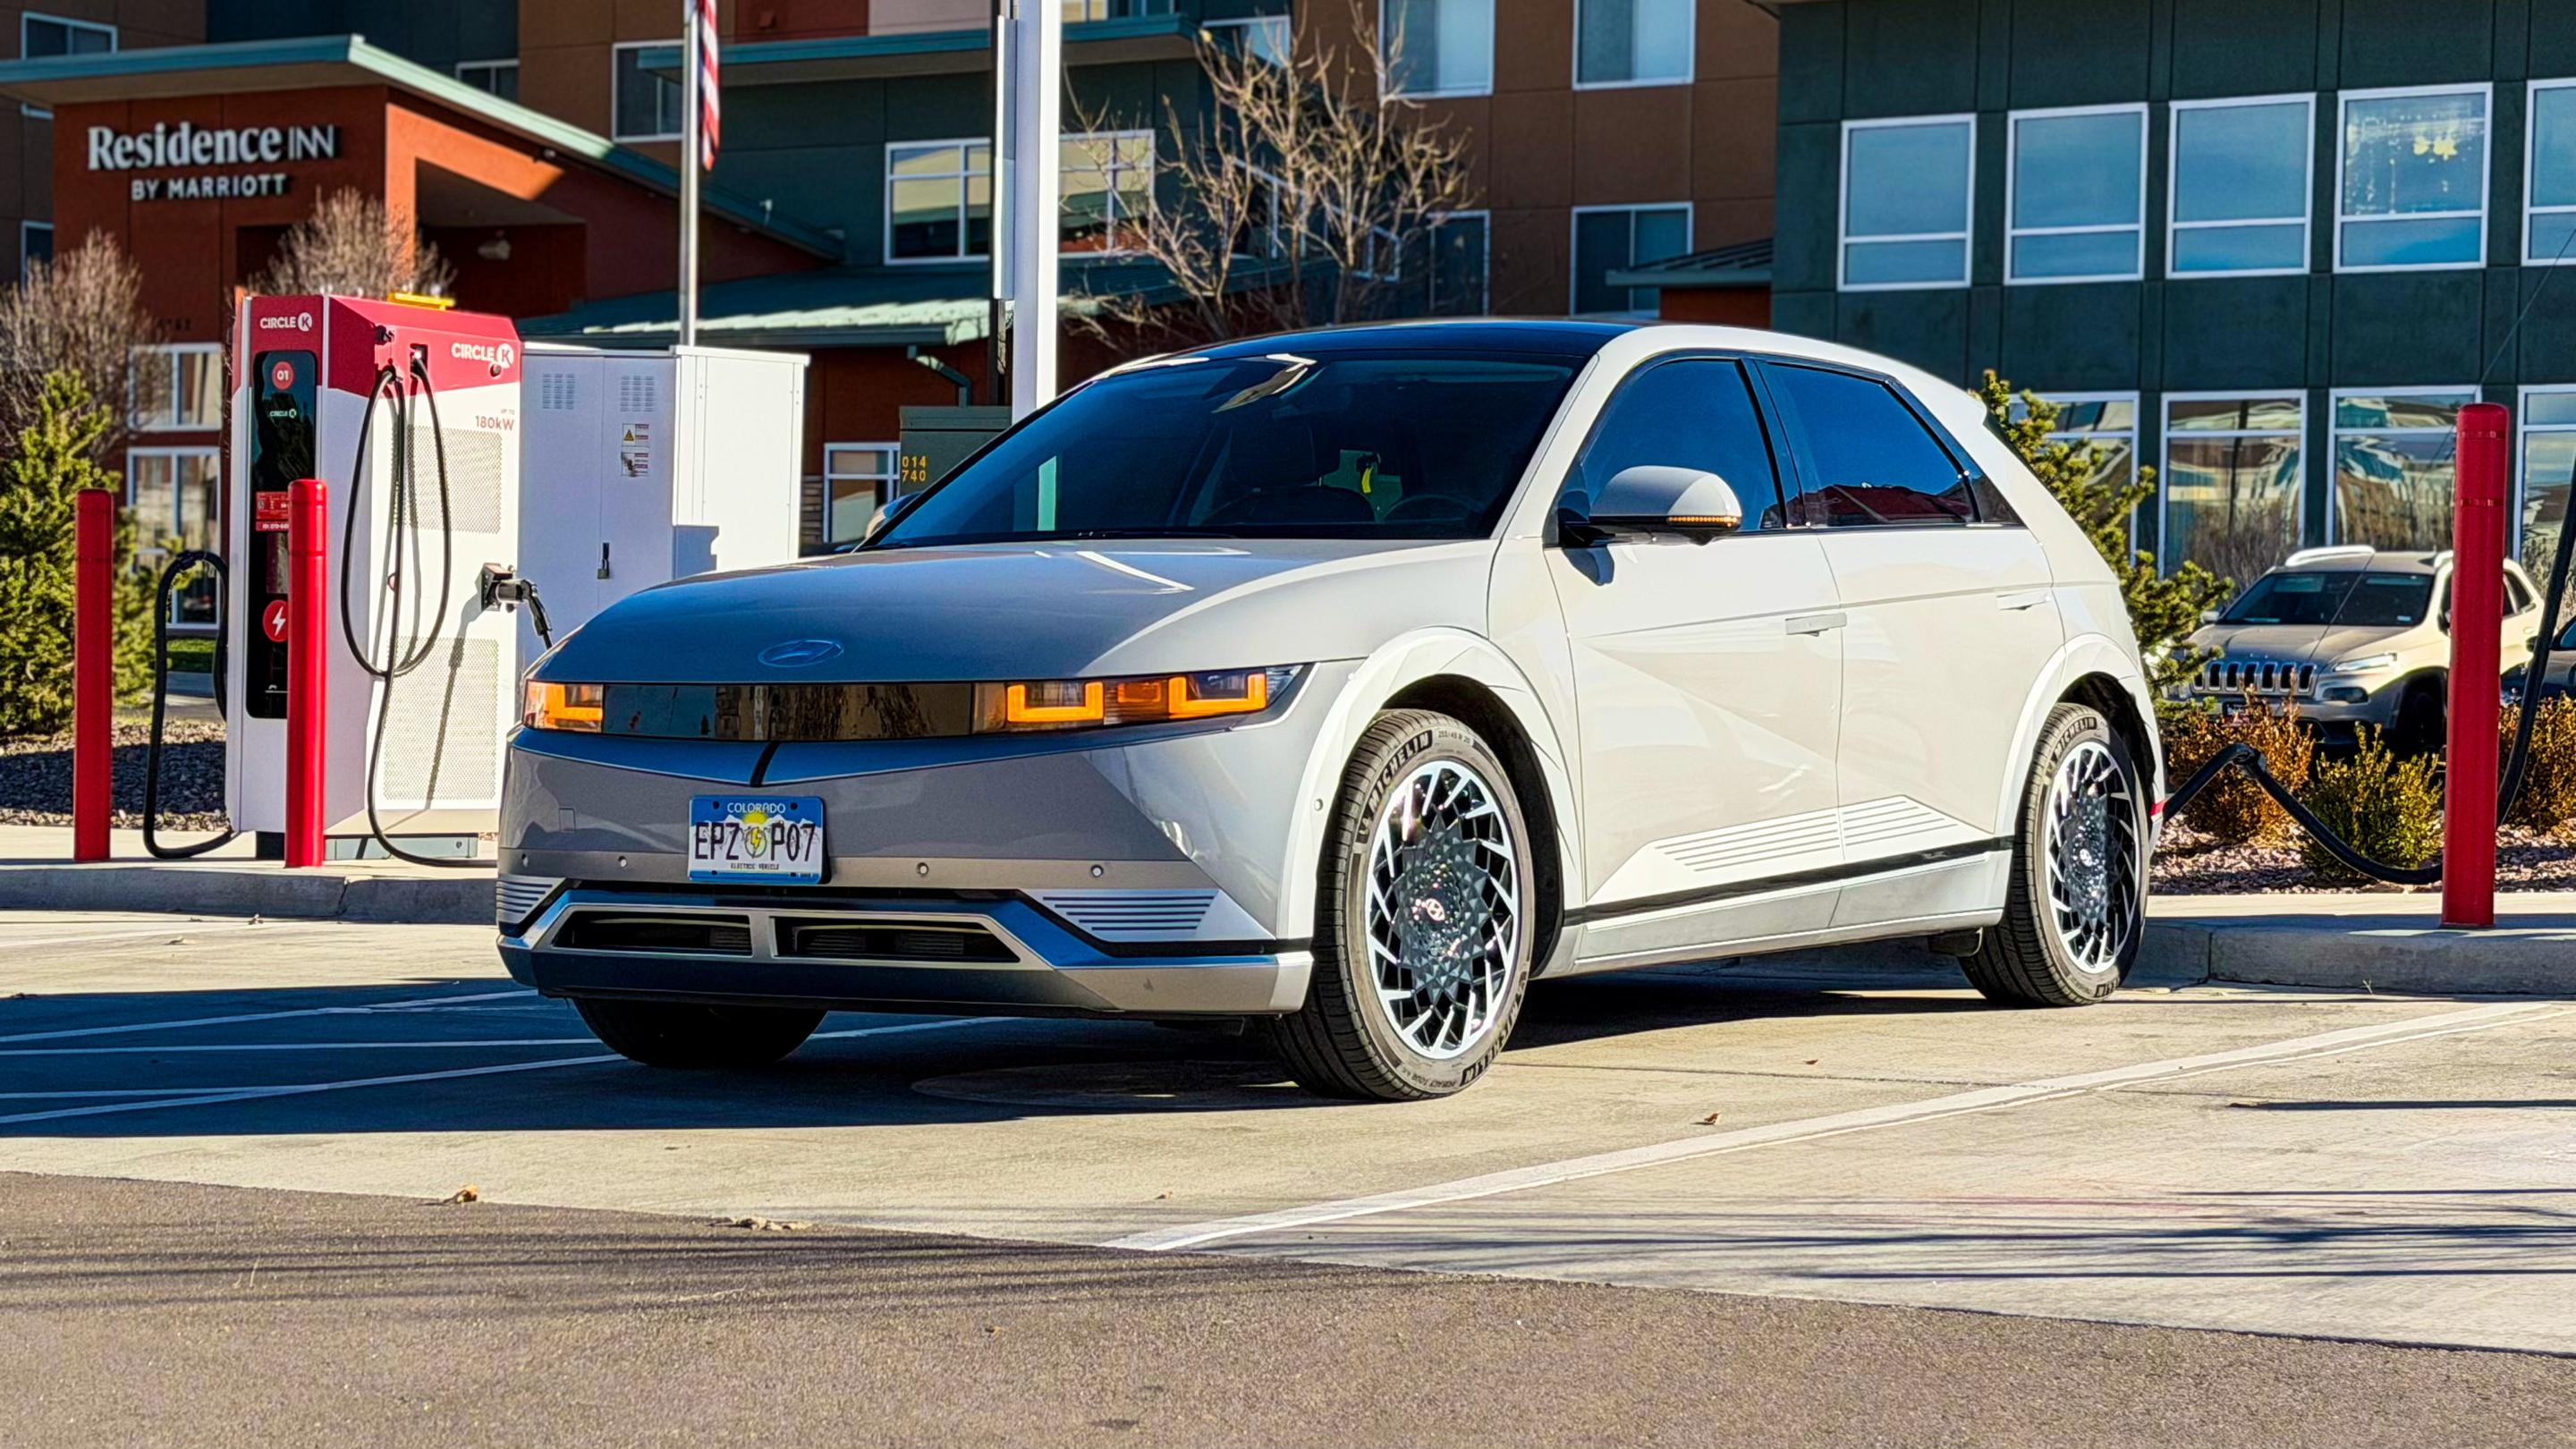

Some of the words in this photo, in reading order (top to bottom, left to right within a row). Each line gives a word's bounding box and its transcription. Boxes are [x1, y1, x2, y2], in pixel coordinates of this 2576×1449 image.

[88, 121, 283, 171] Residence
[288, 124, 335, 160] INN
[131, 179, 159, 201] BY
[167, 174, 286, 199] MARRIOTT
[259, 316, 297, 329] CIRCLE
[299, 314, 312, 331] K
[451, 342, 496, 363] CIRCLE
[498, 345, 513, 368] K
[276, 369, 289, 381] 01
[475, 415, 515, 431] 180kW
[902, 455, 928, 469] 014
[902, 470, 927, 483] 740
[1368, 730, 1431, 814] MICHELIN
[726, 802, 786, 814] COLORADO
[695, 822, 741, 860] EPZ
[770, 822, 816, 862] P07
